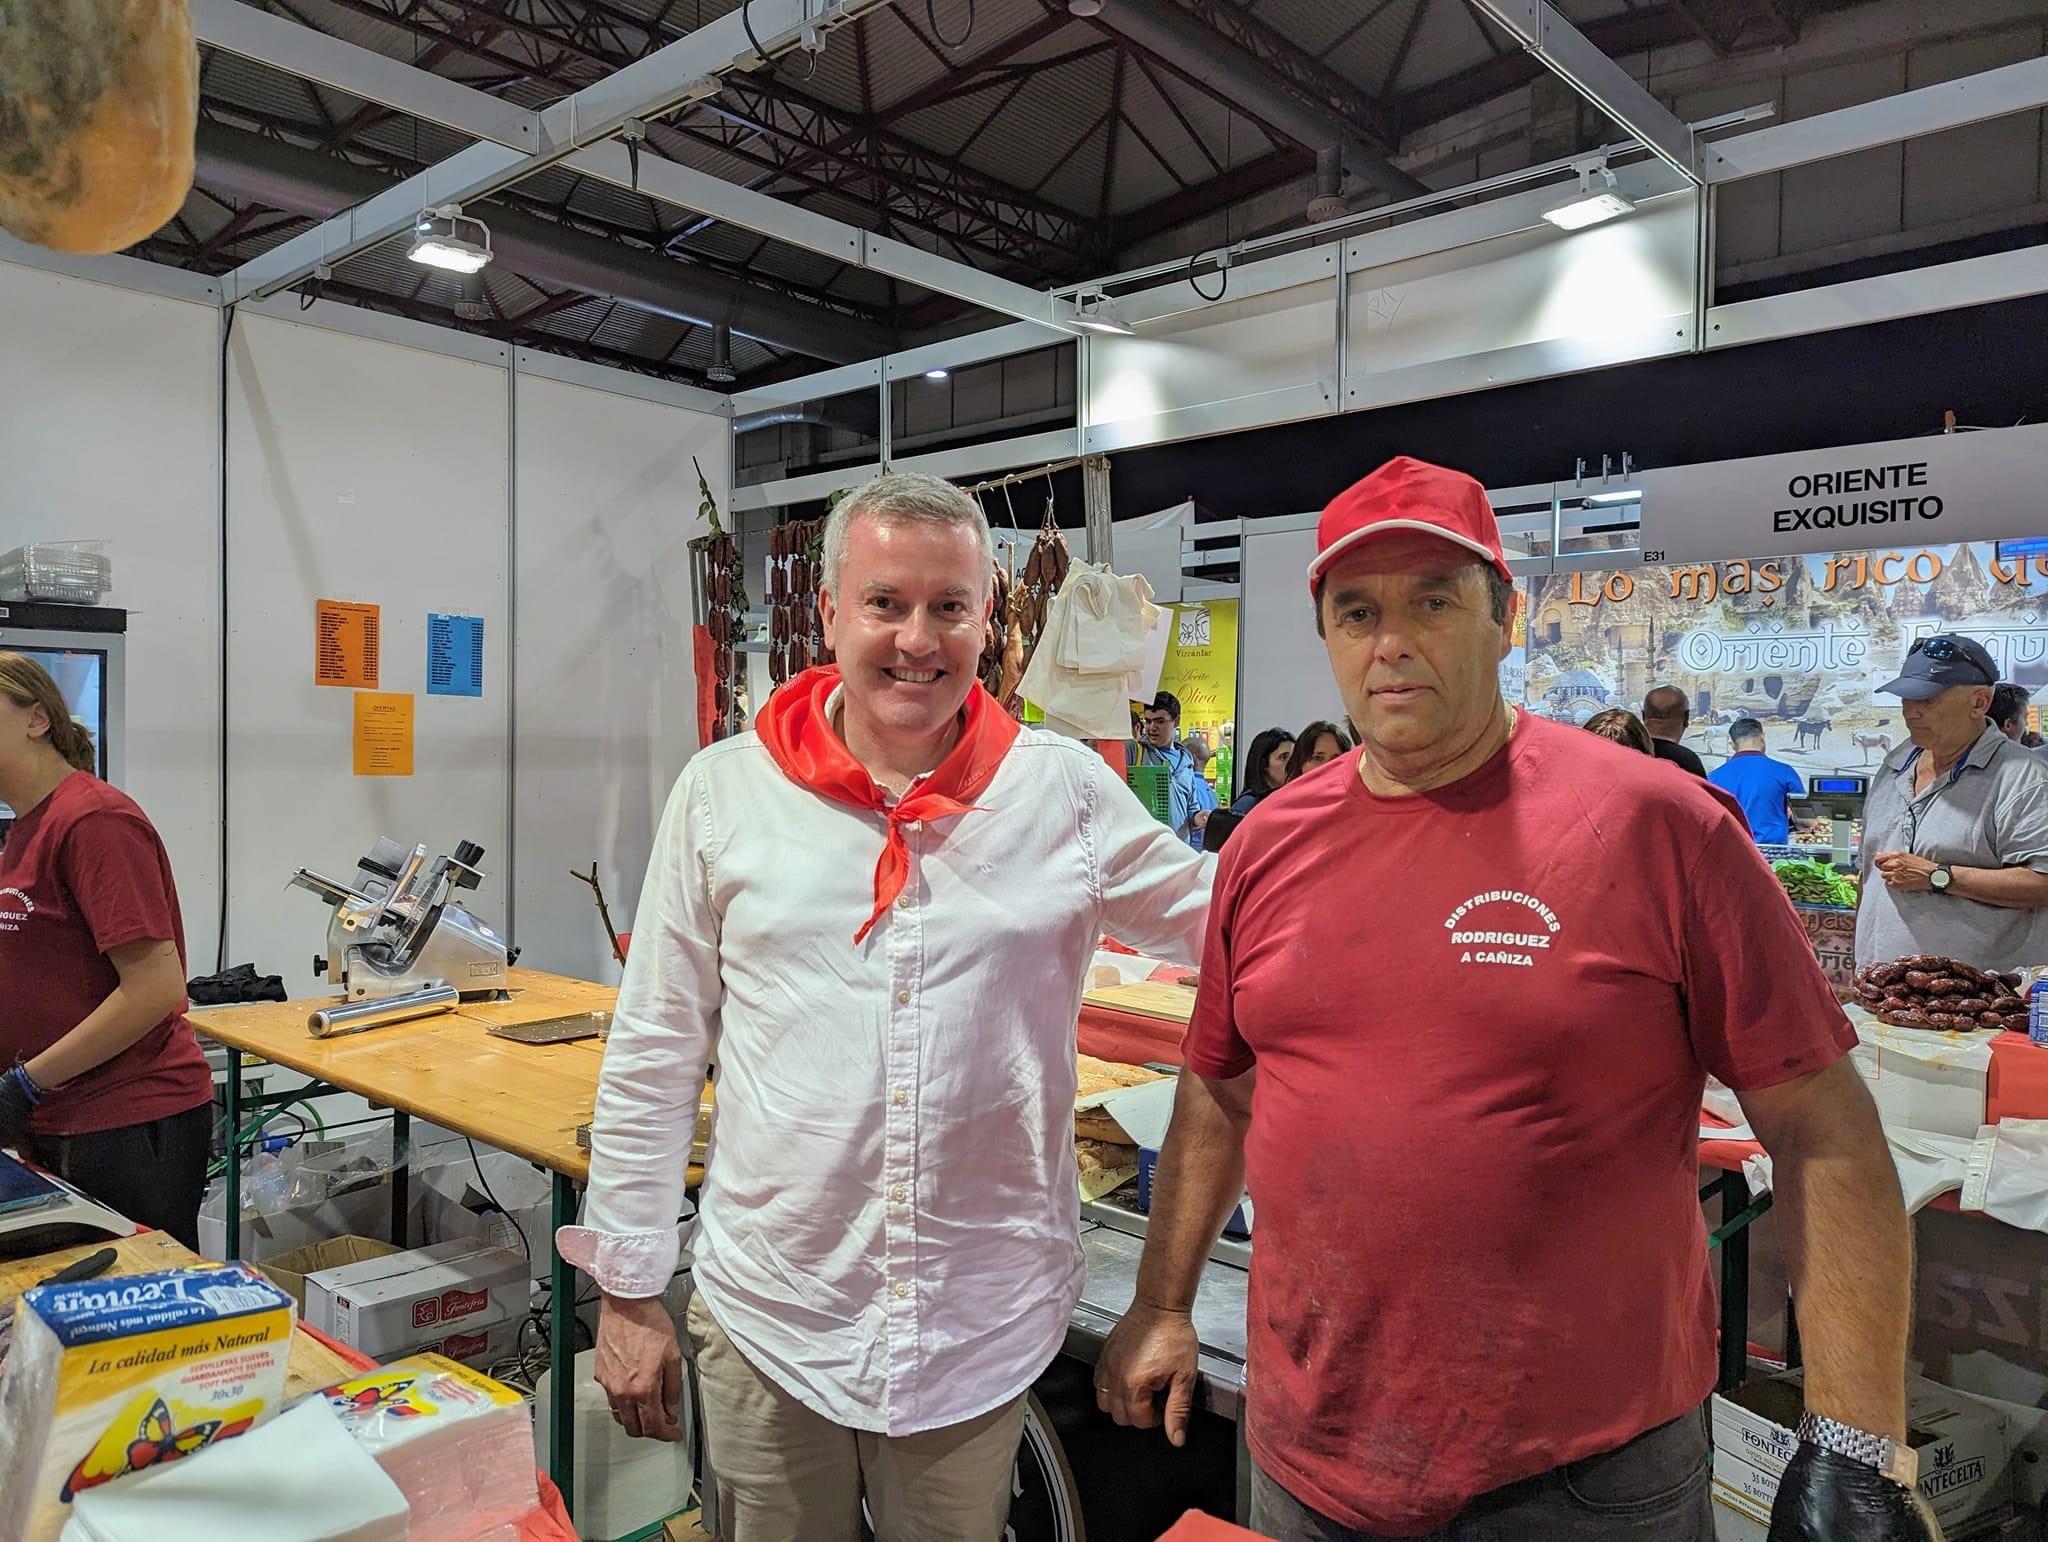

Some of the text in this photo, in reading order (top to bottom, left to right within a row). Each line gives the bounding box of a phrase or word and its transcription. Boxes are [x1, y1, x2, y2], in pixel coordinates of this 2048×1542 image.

[1788, 462, 1928, 498] ORIENTE
[1773, 495, 1944, 533] EXQUISITO
[1643, 550, 1666, 562] E31
[1568, 570, 1634, 607] Lo
[1823, 548, 1943, 593] rico
[1680, 618, 1871, 674] Oriente
[1176, 683, 1217, 705] Oliva
[1444, 890, 1560, 933] DISTRIBUCIONES
[1451, 931, 1550, 948] RODRIGUEZ
[1460, 950, 1533, 966] A CAÑIZA
[146, 1309, 188, 1325] calidad
[88, 1326, 272, 1375] La calidad más Natural
[189, 1351, 270, 1374] SERVILLETAS SUAVES
[246, 1359, 276, 1372] SUAVES
[199, 1372, 257, 1390] SOFT NAPKINS
[209, 1385, 244, 1401] 30x30
[1751, 1472, 1760, 1484] 35
[1743, 1482, 1752, 1494] 35
